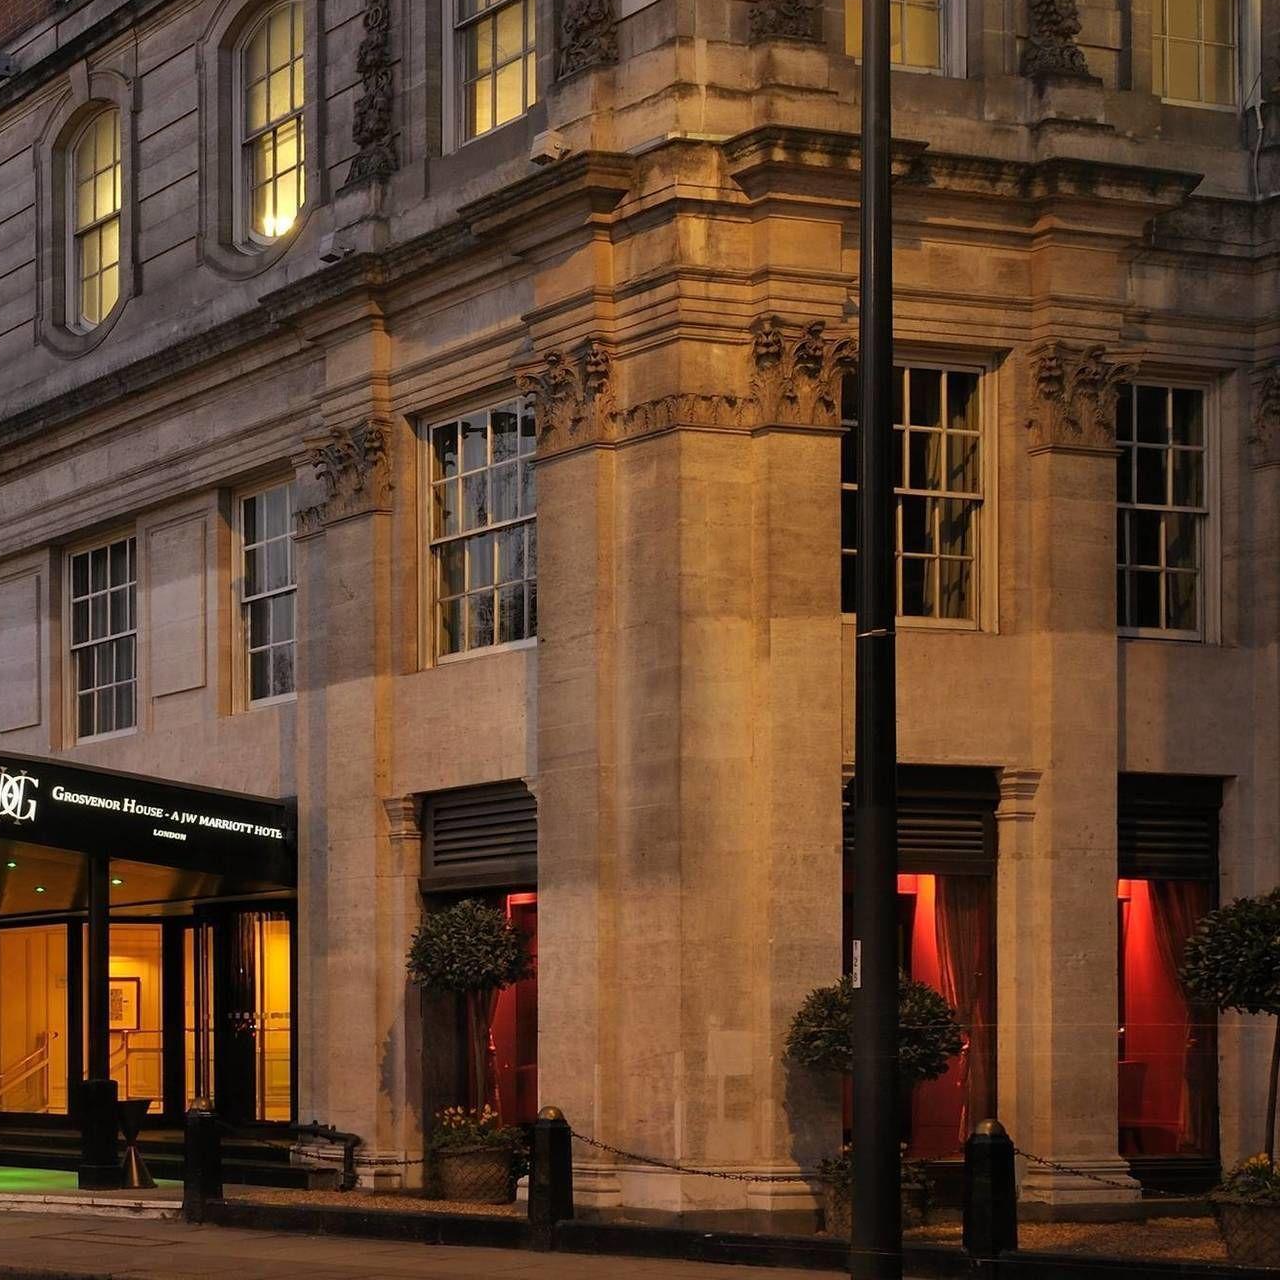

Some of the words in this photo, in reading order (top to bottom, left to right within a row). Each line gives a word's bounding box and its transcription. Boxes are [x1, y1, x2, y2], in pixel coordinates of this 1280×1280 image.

[153, 828, 187, 841] LONDON
[171, 811, 180, 822] A
[180, 812, 198, 824] JW
[199, 815, 254, 834] MARRIOTT
[254, 825, 284, 839] HOTE
